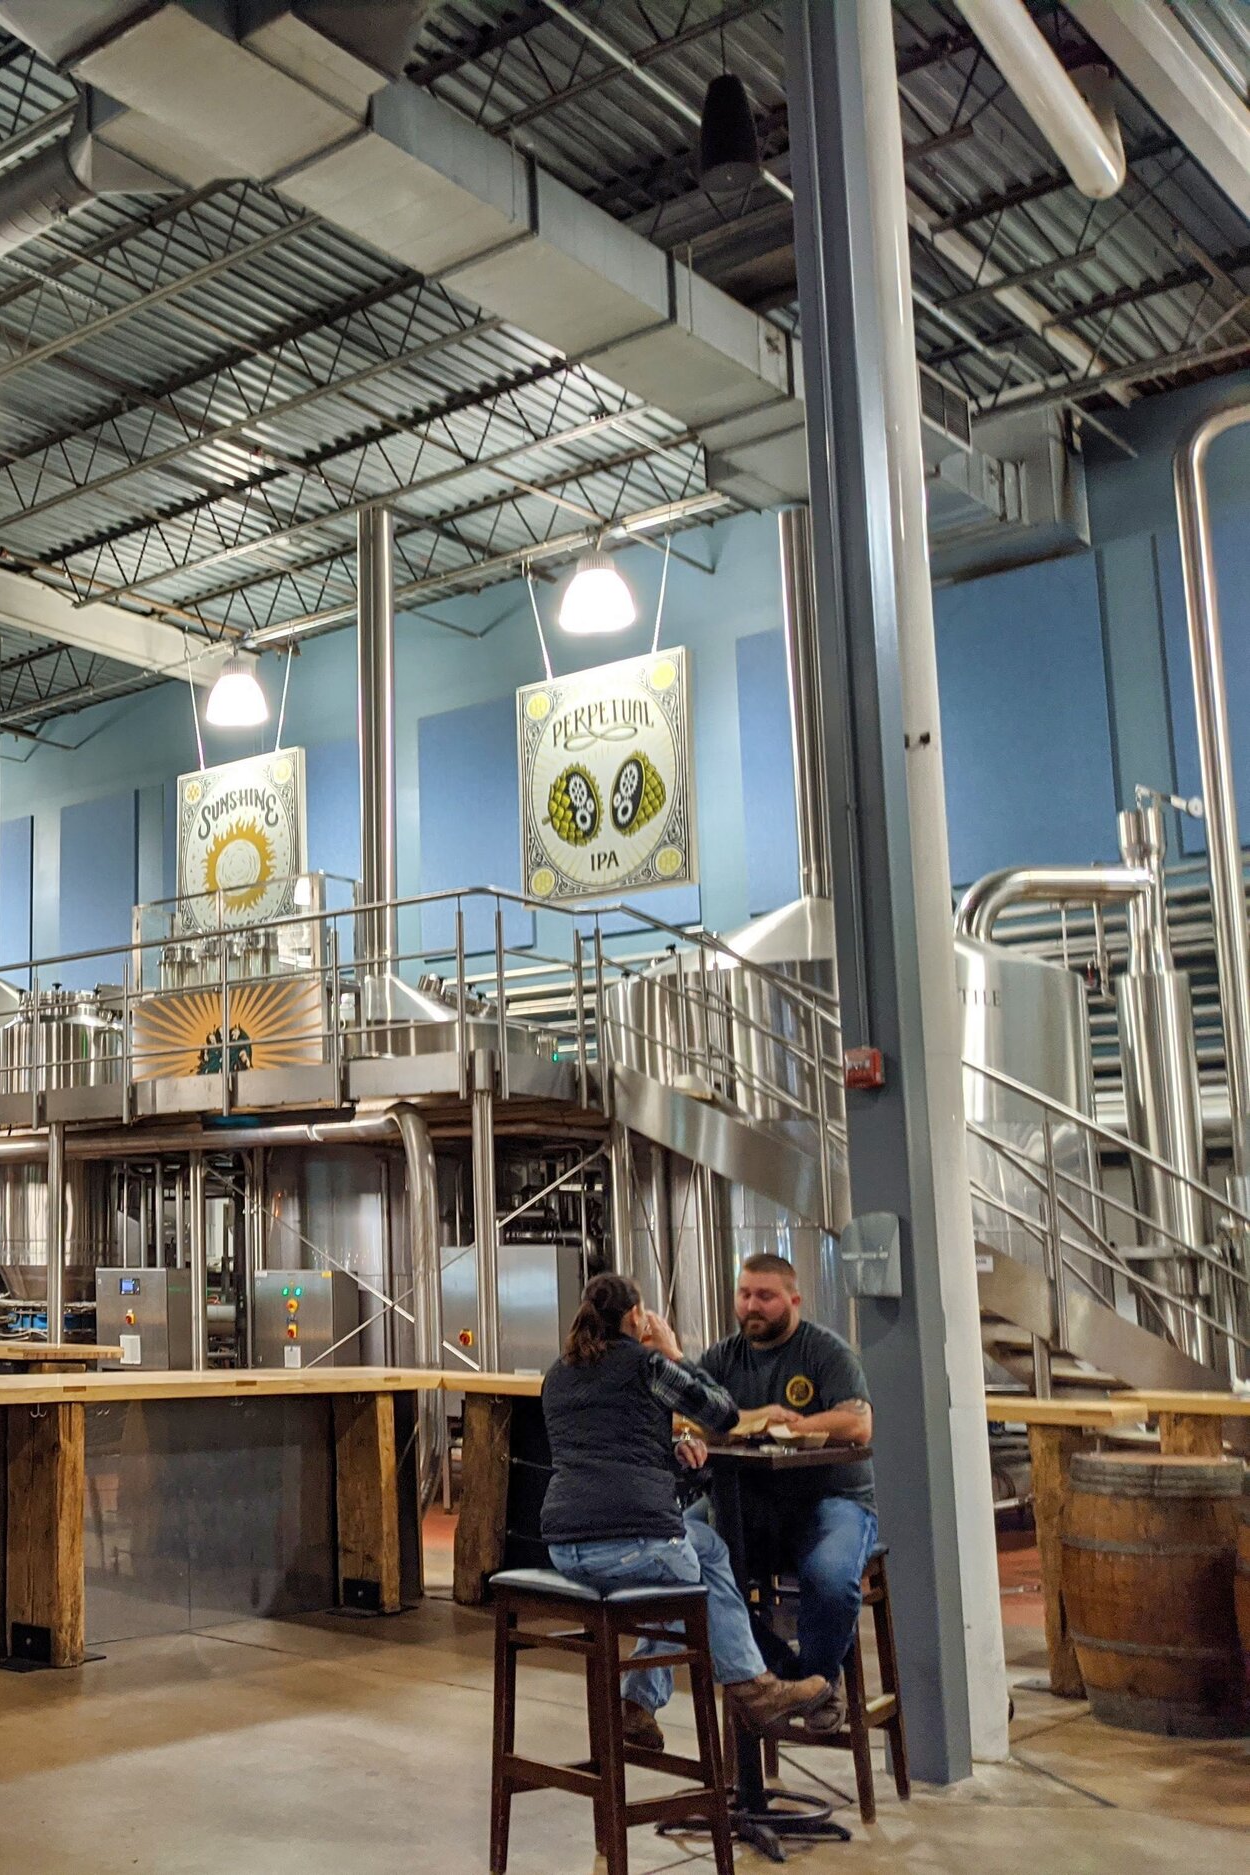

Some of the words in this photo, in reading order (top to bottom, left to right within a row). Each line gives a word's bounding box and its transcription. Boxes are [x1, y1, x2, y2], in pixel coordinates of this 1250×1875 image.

[551, 698, 654, 750] PERPETUAL
[197, 787, 279, 840] SUNSHINE
[590, 850, 620, 872] IPA
